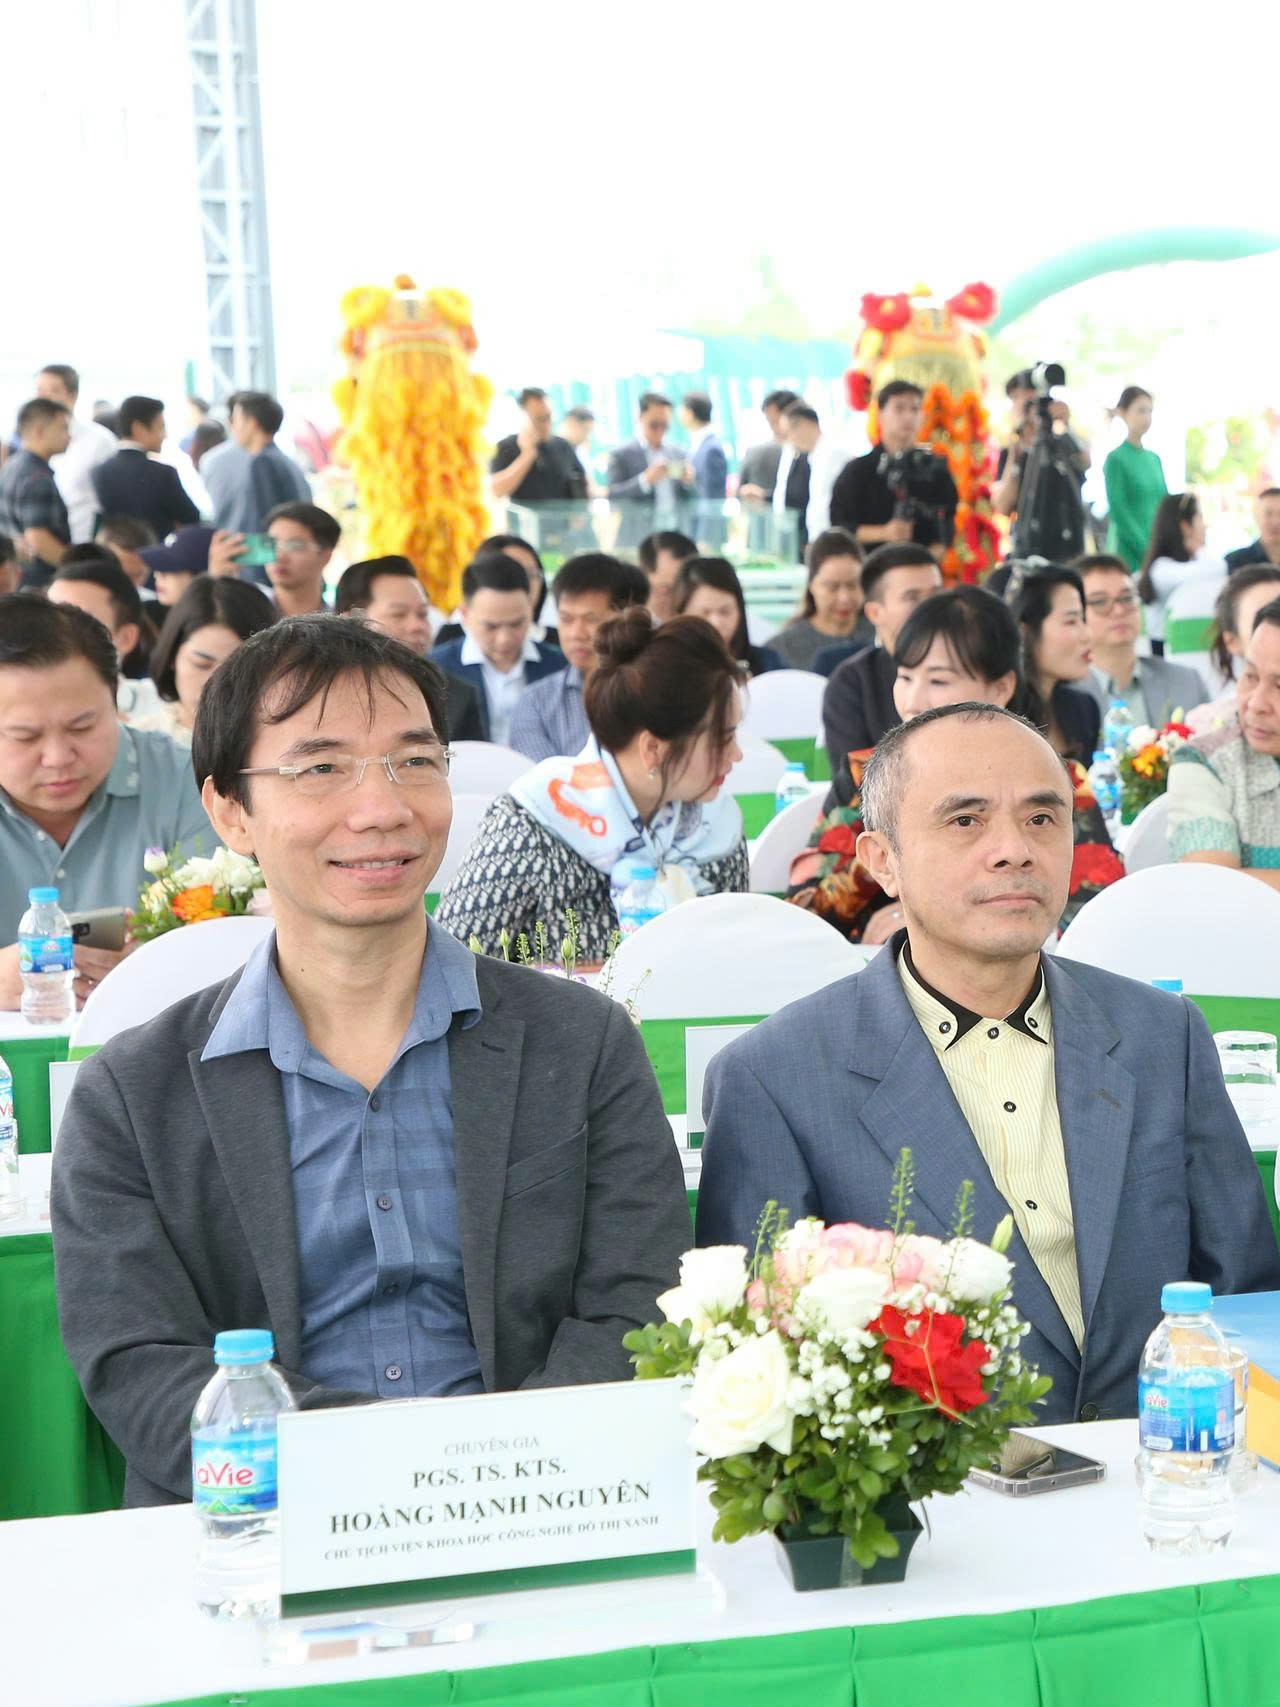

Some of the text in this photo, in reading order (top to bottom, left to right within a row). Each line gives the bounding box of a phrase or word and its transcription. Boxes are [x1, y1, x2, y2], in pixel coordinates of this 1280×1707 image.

[444, 1436, 540, 1456] CHUYÊN GIA
[413, 1458, 567, 1488] PGS. TS. KTS.
[330, 1481, 653, 1534] HOÀNG MẠNH NGUYÊN
[358, 1544, 389, 1557] TỊCH
[392, 1538, 423, 1554] VIỆN
[427, 1538, 463, 1551] KHOA
[468, 1533, 495, 1547] HỌC
[498, 1528, 534, 1542] CÔNG
[578, 1520, 596, 1533] ĐÔ
[601, 1520, 622, 1531] THỊ
[624, 1516, 659, 1529] XANH
